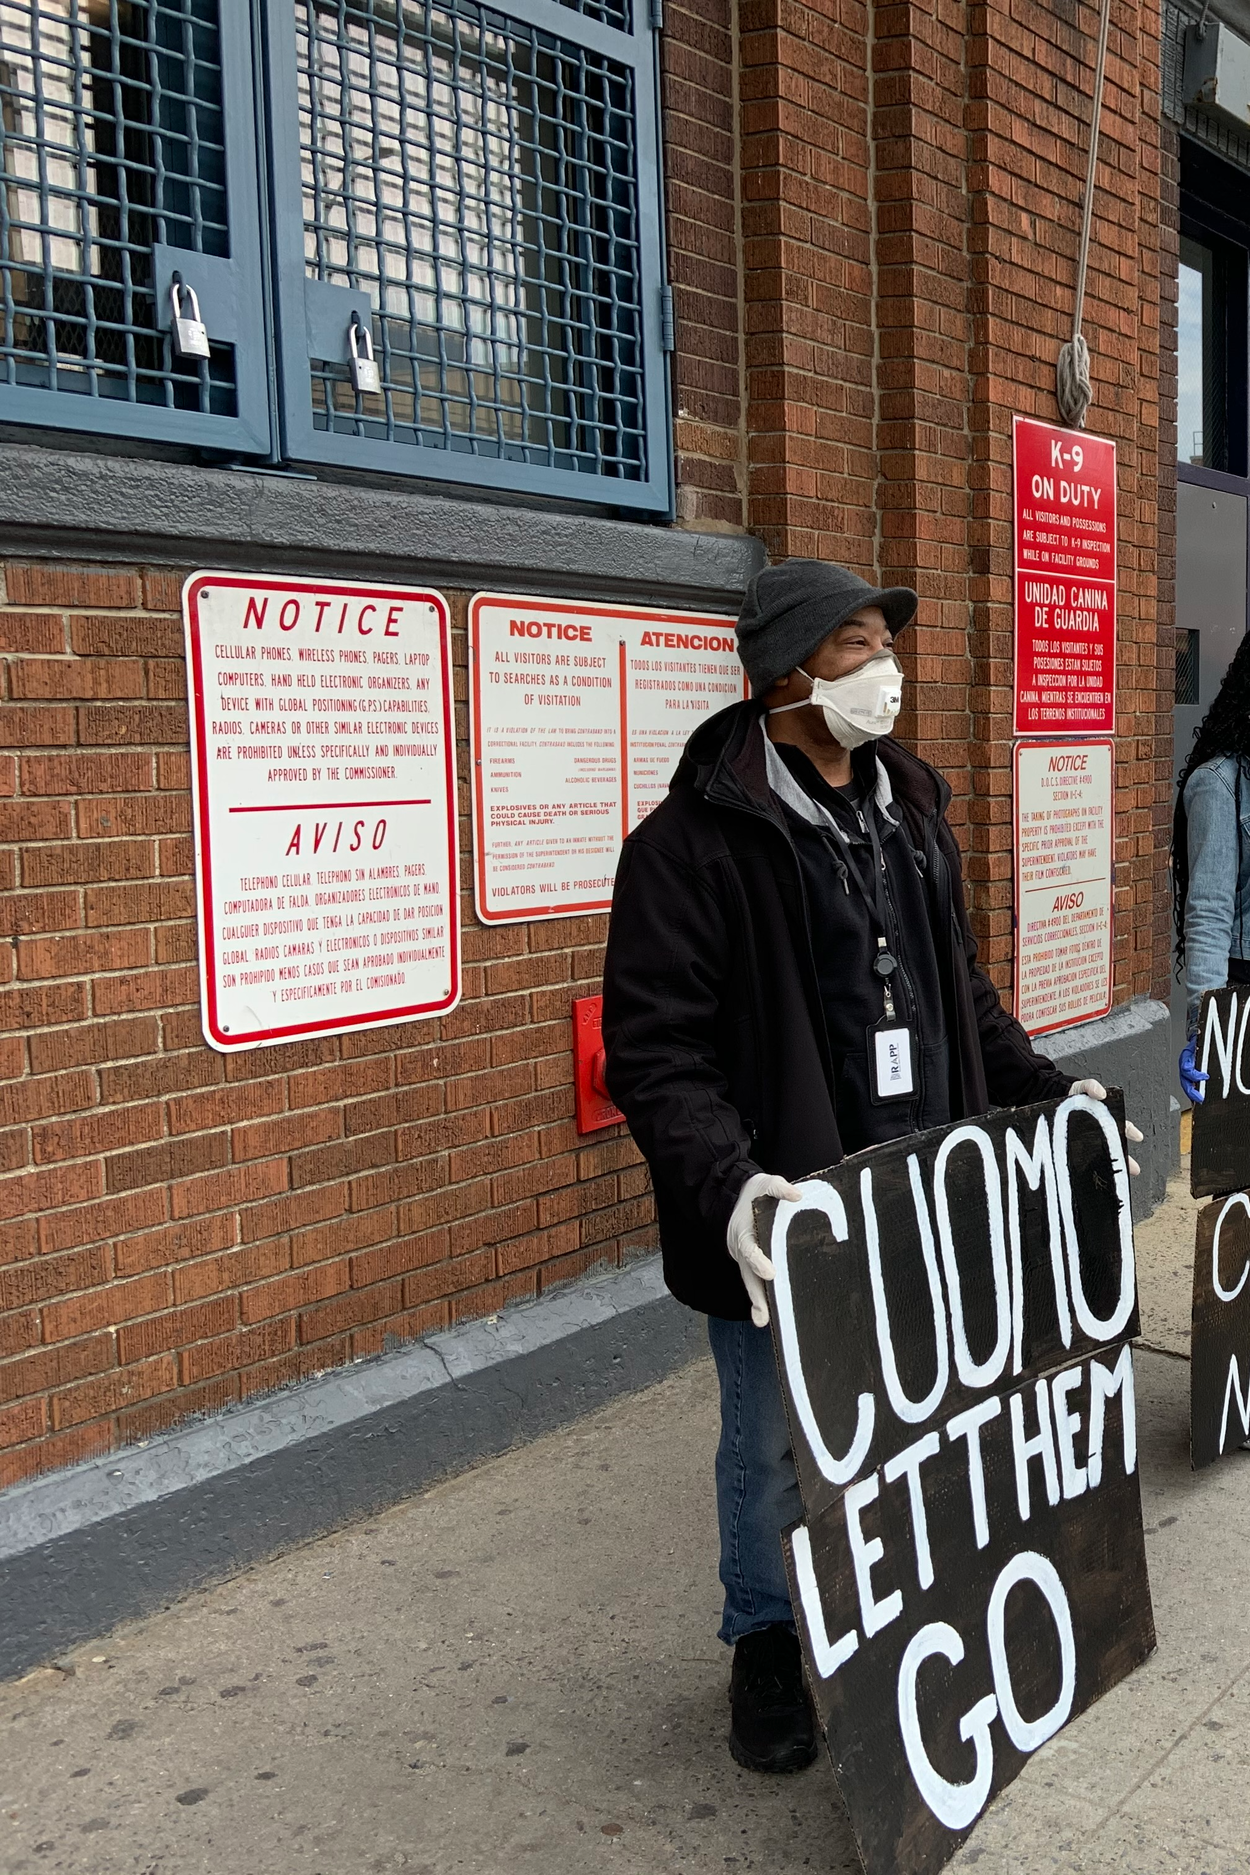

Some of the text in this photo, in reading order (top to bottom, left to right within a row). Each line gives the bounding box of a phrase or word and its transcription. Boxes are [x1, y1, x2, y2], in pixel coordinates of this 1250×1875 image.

[1051, 439, 1084, 472] K-9
[1032, 475, 1101, 509] ON DUTY
[1023, 508, 1106, 533] ALL VISITORS AND POSSESSIONS
[1023, 530, 1110, 553] ARE SUBJECT TO K-9 INSPECTION
[1023, 548, 1100, 570] WHILE ON FACILITY GROUNDS
[1025, 581, 1108, 610] UNIDAD CANINA
[243, 596, 404, 637] NOTICE
[1035, 607, 1099, 632] DE GUARDIA
[509, 620, 593, 642] NOTICE
[640, 631, 734, 652] ATENCION
[215, 645, 256, 660] CELLULAR
[298, 648, 335, 662] WIRELESS
[404, 653, 430, 666] LAPTOP
[495, 651, 606, 668] ALL VISITORS ARE SUBJECT
[631, 660, 740, 675] TODOS LOS VISITANTES TIENEN QUE SER
[271, 673, 292, 687] HAND
[297, 674, 316, 687] HELD
[321, 675, 363, 689] ELECTRONIC
[416, 678, 430, 690] ANY
[489, 672, 612, 688] TO SEARCHES AS A CONDITION
[635, 679, 676, 691] REGISTRADOS
[678, 681, 693, 691] COMO
[708, 682, 737, 693] CONDICION
[221, 697, 250, 711] DEVICE
[255, 698, 274, 711] WITH
[278, 698, 307, 711] GLOBAL
[313, 699, 357, 712] POSITIONING
[524, 694, 581, 706] OF VISITATION
[250, 721, 287, 734] CAMERAS
[291, 722, 301, 734] OR
[306, 722, 329, 734] OTHER
[334, 722, 363, 734] SIMILAR
[367, 722, 408, 734] ELECTRONIC
[412, 722, 438, 734] DEVICES
[216, 744, 438, 759] ARE PROHIBITED UNLESS SPECIFICALLY AND INDIVIDUALLY
[1048, 755, 1088, 772] NOTICE
[267, 767, 307, 782] APPROVED
[312, 767, 322, 781] BY
[327, 767, 340, 780] THE
[285, 819, 387, 856] AVISO
[492, 877, 614, 897] VIOLATORS WILL BE PROSECUTE
[1052, 891, 1084, 913] AVISO
[770, 1092, 1136, 1486] CUOMO
[791, 1342, 1138, 1679] LET THEM
[898, 1550, 1077, 1831] GO
